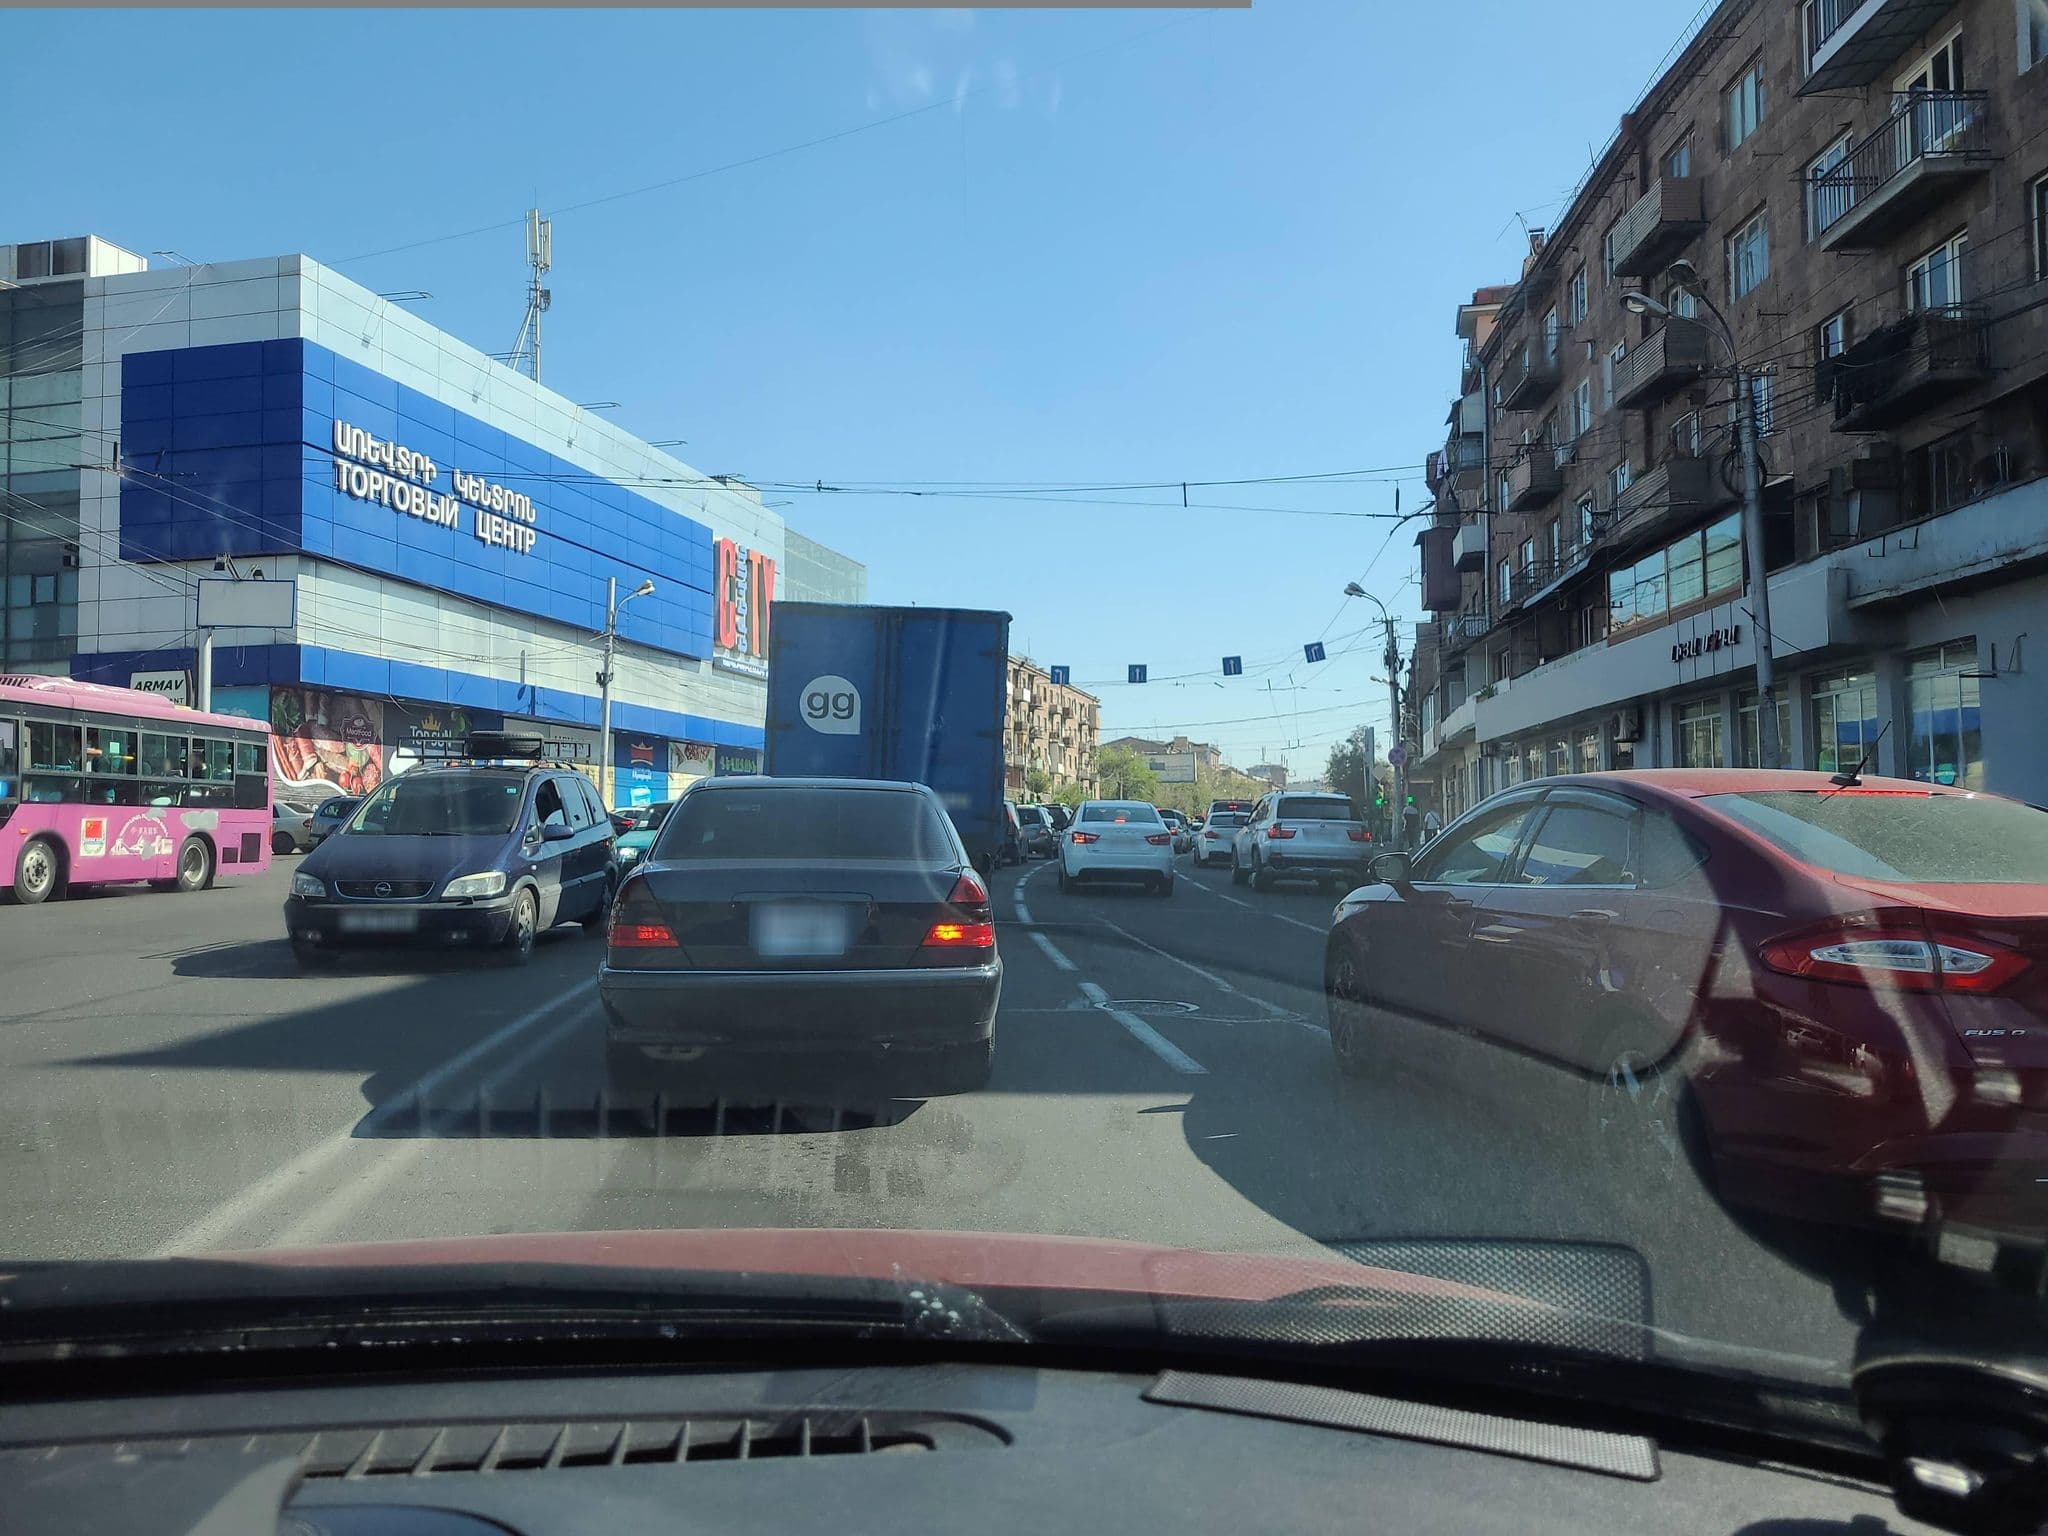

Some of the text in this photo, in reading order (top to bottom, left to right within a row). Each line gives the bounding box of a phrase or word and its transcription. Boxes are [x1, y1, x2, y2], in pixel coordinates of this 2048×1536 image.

[333, 458, 536, 553] ТОРГОВЫЙ ЦЕНТР
[134, 680, 184, 691] ARMAV
[807, 692, 855, 719] gg
